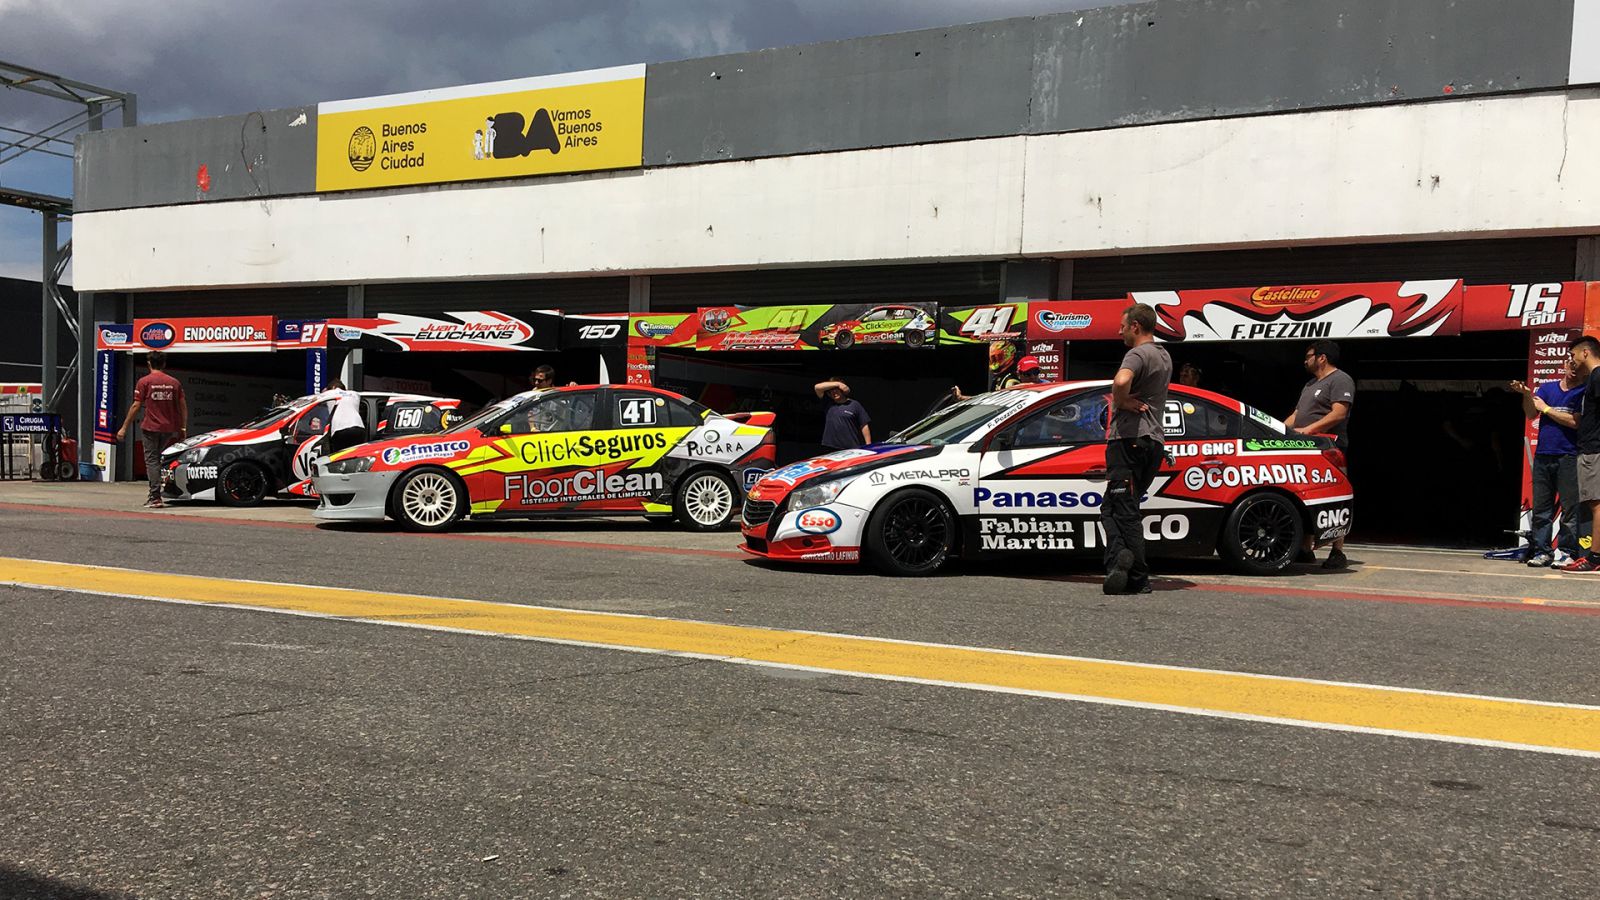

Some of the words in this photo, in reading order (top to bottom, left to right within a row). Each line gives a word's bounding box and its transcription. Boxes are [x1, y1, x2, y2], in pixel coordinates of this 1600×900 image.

[551, 107, 591, 122] Vamos
[382, 122, 426, 137] Buenos
[558, 120, 602, 134] Buenos
[382, 140, 414, 153] Aires
[565, 134, 598, 148] Aires
[380, 153, 424, 170] Ciudad
[1252, 286, 1321, 302] Castellano
[1507, 283, 1562, 317] 16
[767, 310, 807, 329] 41
[962, 307, 1014, 336] 41
[1054, 313, 1090, 321] Turismo
[1522, 310, 1566, 327] Fabri
[184, 326, 254, 340] ENDOGROUP
[254, 331, 267, 340] SRL
[301, 324, 325, 343] 27
[415, 331, 514, 340] ELUCHANS
[420, 324, 458, 332] Juan
[578, 324, 621, 339] 150
[1230, 324, 1247, 340] F.
[1248, 322, 1332, 339] PEZZINI
[1039, 355, 1059, 363] RUS
[1548, 348, 1572, 356] RU
[397, 408, 421, 428] 150
[622, 401, 654, 424] 41
[994, 408, 1018, 424] Pezzini
[1163, 404, 1180, 428] 6
[520, 432, 666, 464] ClickSeguros
[687, 440, 745, 457] PUCARA
[1202, 442, 1235, 456] GNC
[1262, 440, 1317, 448] ECOGROUP
[187, 465, 218, 480] TOXFREE
[890, 469, 970, 480] METALPRO
[1206, 465, 1308, 488] CORADIR
[1311, 470, 1337, 484] S.A.
[504, 470, 664, 500] FloorClean
[522, 496, 560, 504] SISTEMAS
[561, 494, 606, 502] INTEGRALES
[802, 514, 835, 528] Esso
[980, 517, 1074, 534] Fabian
[1317, 508, 1350, 529] GNC
[1083, 514, 1190, 548] ICO
[982, 534, 1075, 550] Martin
